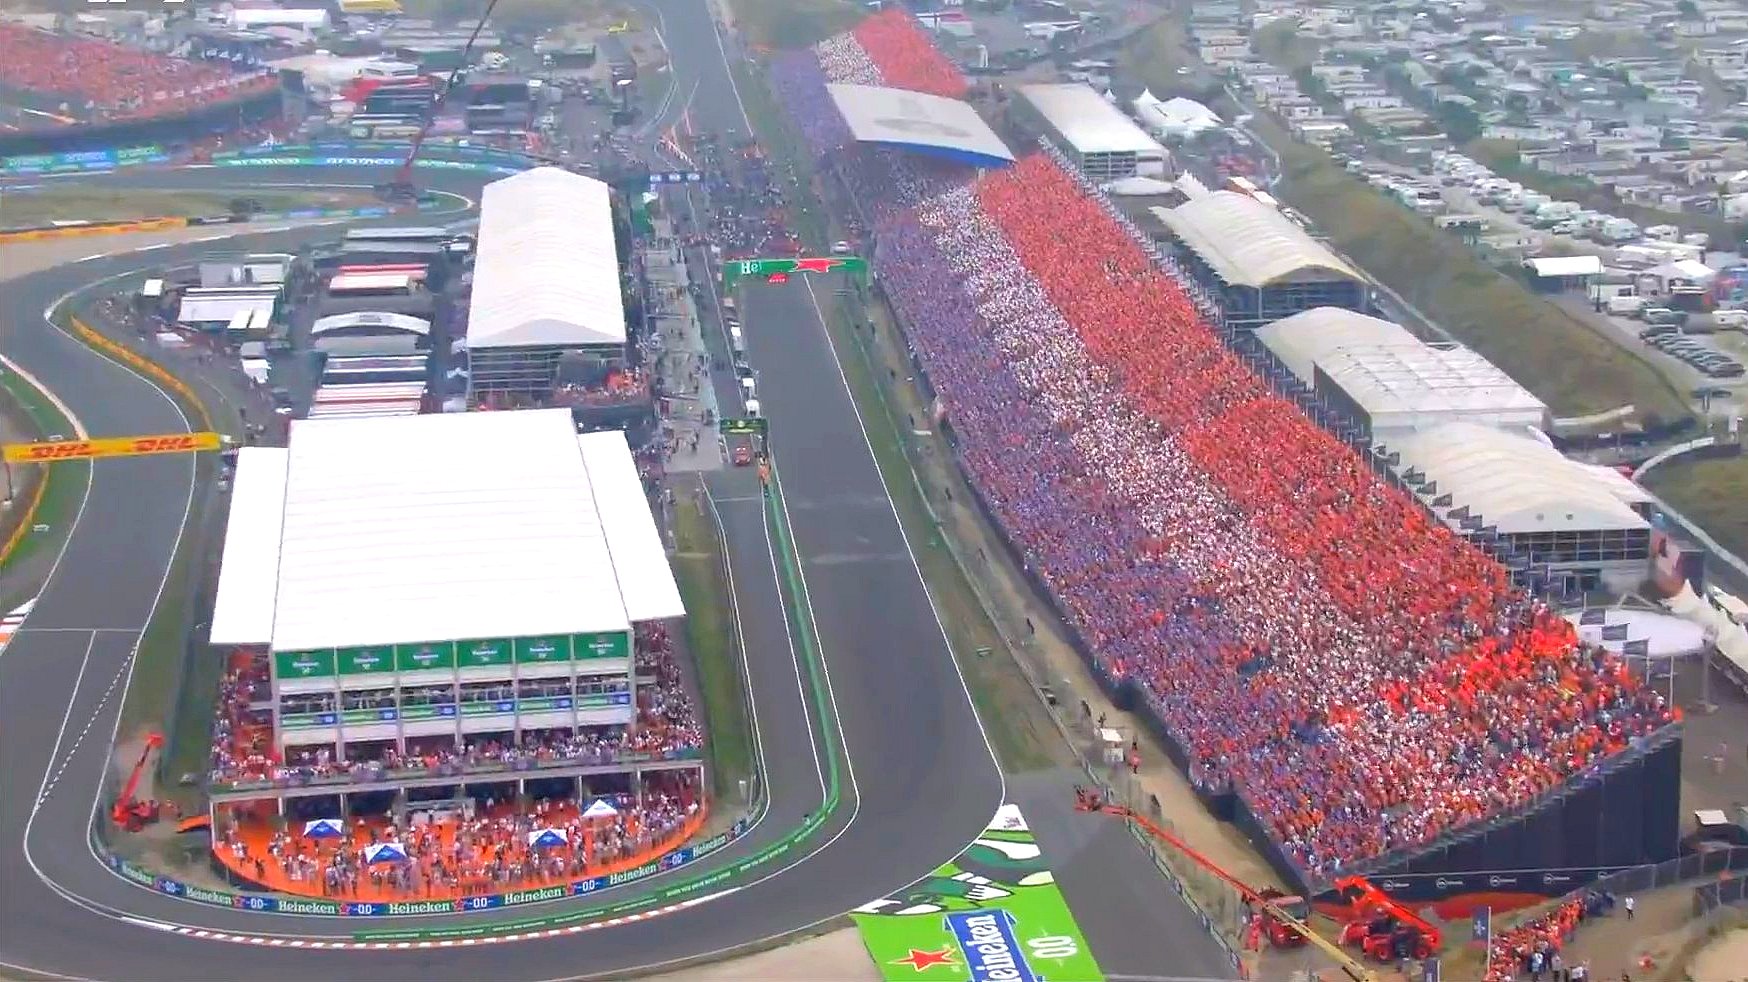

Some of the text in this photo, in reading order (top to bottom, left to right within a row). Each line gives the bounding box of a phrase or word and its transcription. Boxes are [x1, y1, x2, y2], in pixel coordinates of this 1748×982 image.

[609, 863, 658, 885] Heineken
[504, 888, 562, 905] Heineken
[278, 901, 335, 914] Heineken
[389, 902, 450, 915] Heineken
[965, 914, 1022, 982] eineken
